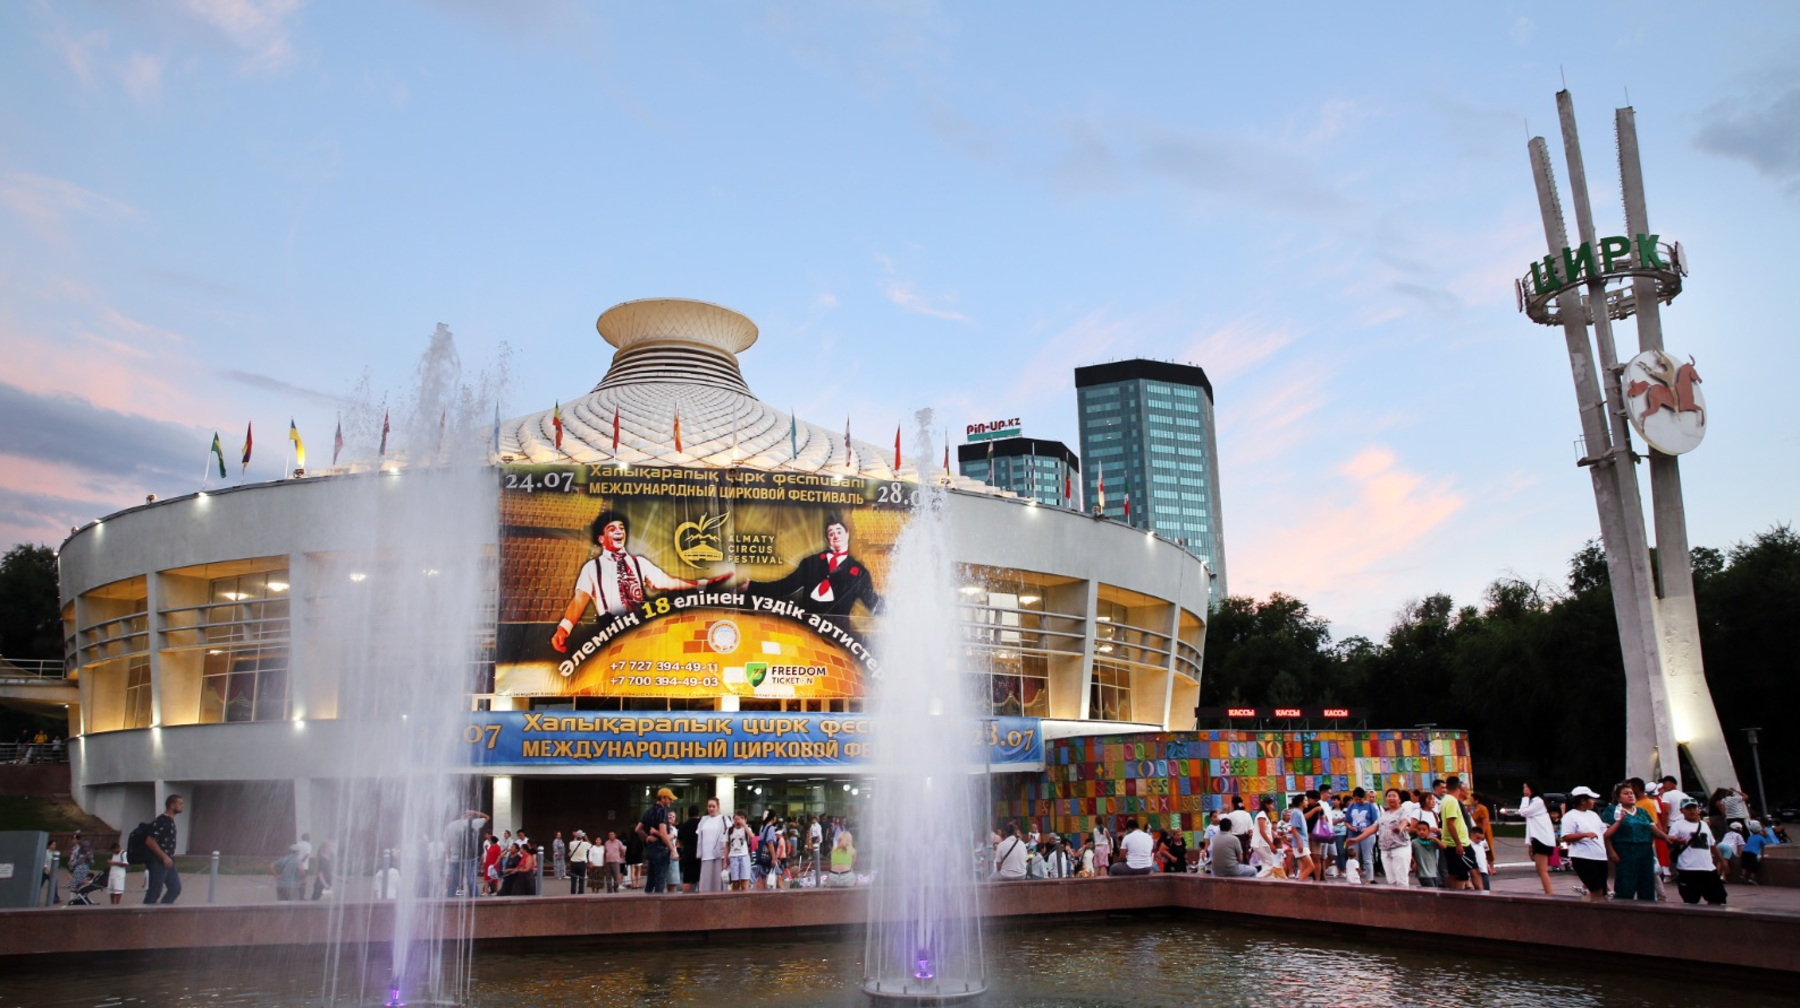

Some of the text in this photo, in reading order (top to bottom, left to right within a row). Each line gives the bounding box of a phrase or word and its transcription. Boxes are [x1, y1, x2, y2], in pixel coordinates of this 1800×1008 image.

[1530, 233, 1664, 295] ЦИРК
[590, 464, 865, 489] Халықаралық цирк фестивалі
[505, 472, 575, 493] 24.07
[589, 482, 864, 505] МЕЖДУНАРОДНЫЙ ЦИРКОВОЙ ФЕСТИВАЛЬ
[728, 535, 775, 543] ALMATY
[728, 545, 773, 554] CIRCUS
[728, 555, 784, 565] FESTIVAL
[558, 612, 640, 678] Әлемнің
[641, 597, 671, 619] 18
[674, 591, 744, 609] елінен
[751, 595, 806, 620] үздік
[610, 661, 719, 672] +7 727 394-49-11
[771, 666, 826, 676] FREEDOM
[610, 676, 719, 687] +7 700 394-49-03
[1228, 709, 1255, 717] КАССЫ
[1275, 709, 1301, 717] КАССЫ
[1323, 709, 1349, 717] КАССЫ
[522, 713, 733, 737] Халықаралық
[741, 717, 810, 737] цирк
[522, 738, 728, 760] МЕЖДУНАРОДНЫЙ
[733, 738, 839, 760] ЦИРКОВОЙ
